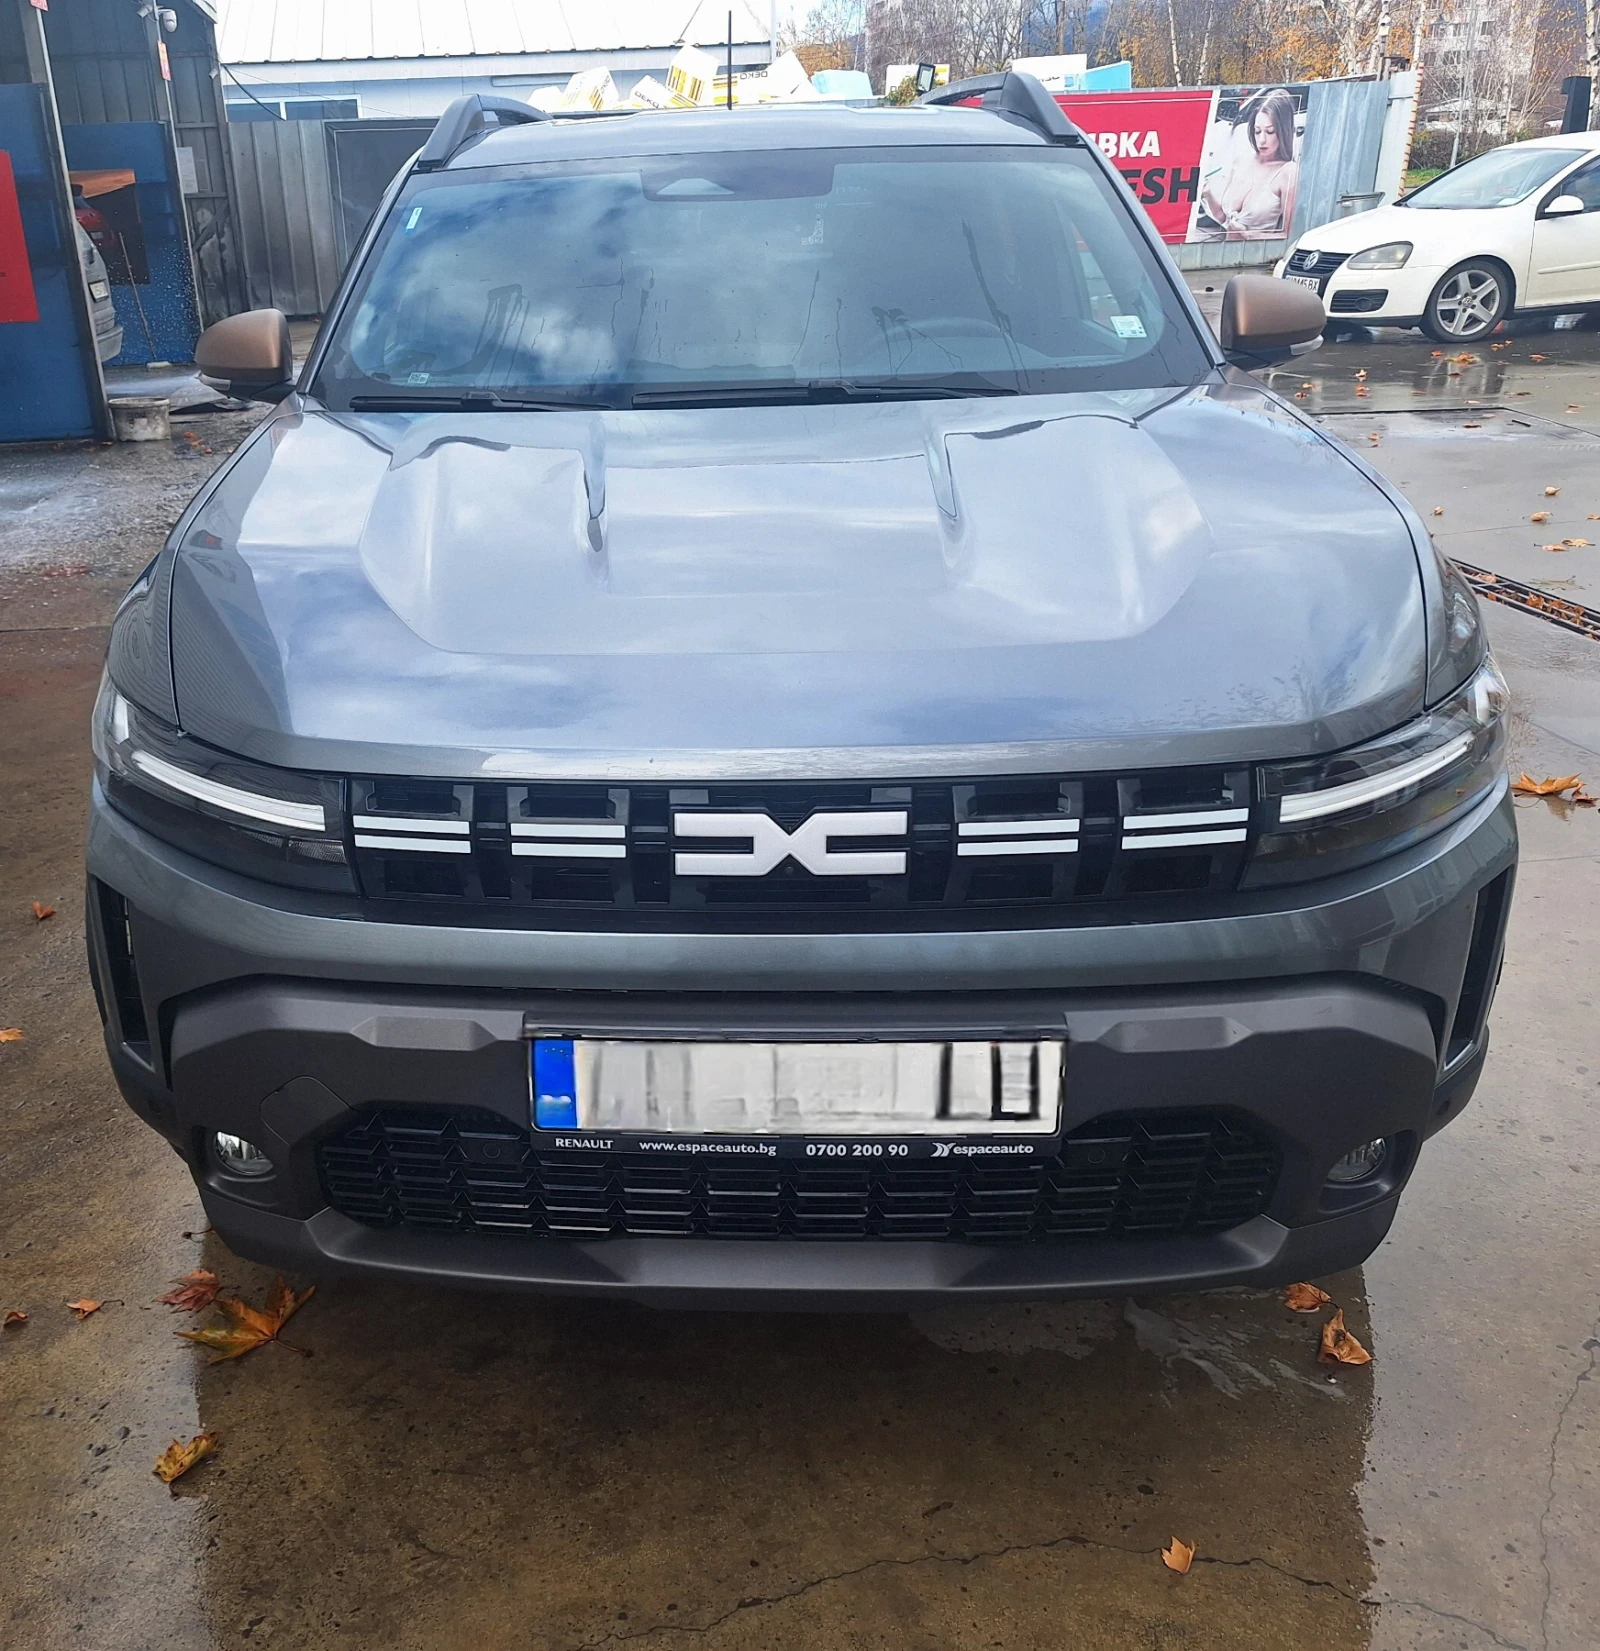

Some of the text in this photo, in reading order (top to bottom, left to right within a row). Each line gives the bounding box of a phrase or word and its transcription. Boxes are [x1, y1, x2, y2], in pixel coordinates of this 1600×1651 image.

[555, 1138, 1034, 1156] RENAULT www.espaceauto.bg 0700 200 90 espaceauto
